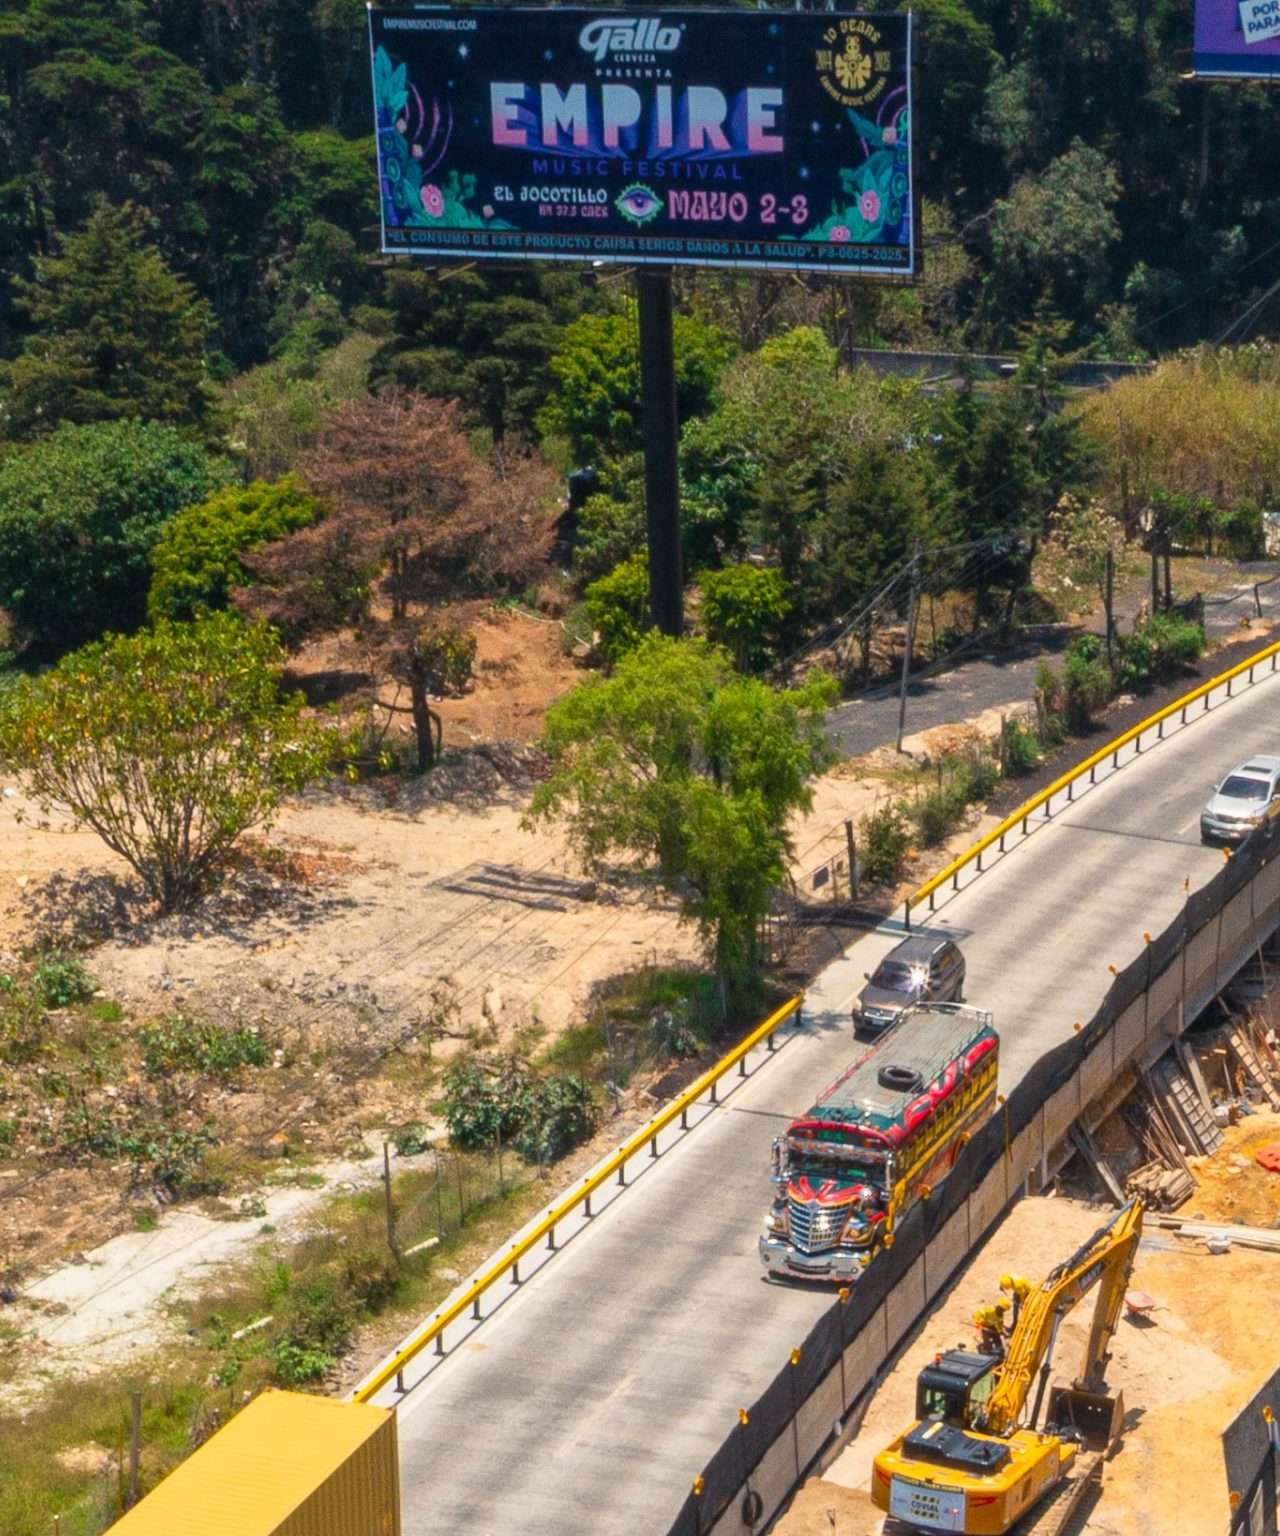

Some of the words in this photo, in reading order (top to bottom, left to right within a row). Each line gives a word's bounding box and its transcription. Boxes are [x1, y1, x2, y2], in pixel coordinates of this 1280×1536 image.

[1251, 1, 1280, 18] POR
[613, 54, 657, 63] CERVEZA
[595, 68, 673, 79] PRESENTA
[489, 81, 785, 154] EMPIRE
[532, 158, 609, 177] MUSIC
[623, 159, 744, 182] FESTIVAL
[494, 186, 514, 201] EL
[667, 189, 748, 223] MAYO
[760, 193, 809, 225] 2-3
[410, 231, 470, 245] CONSUMO
[473, 233, 490, 245] DE
[491, 234, 522, 246] ESTE
[524, 235, 591, 249] PRODUCTO
[593, 238, 635, 251] CAUSA
[638, 239, 684, 252] SERIOS
[744, 243, 762, 256] LA
